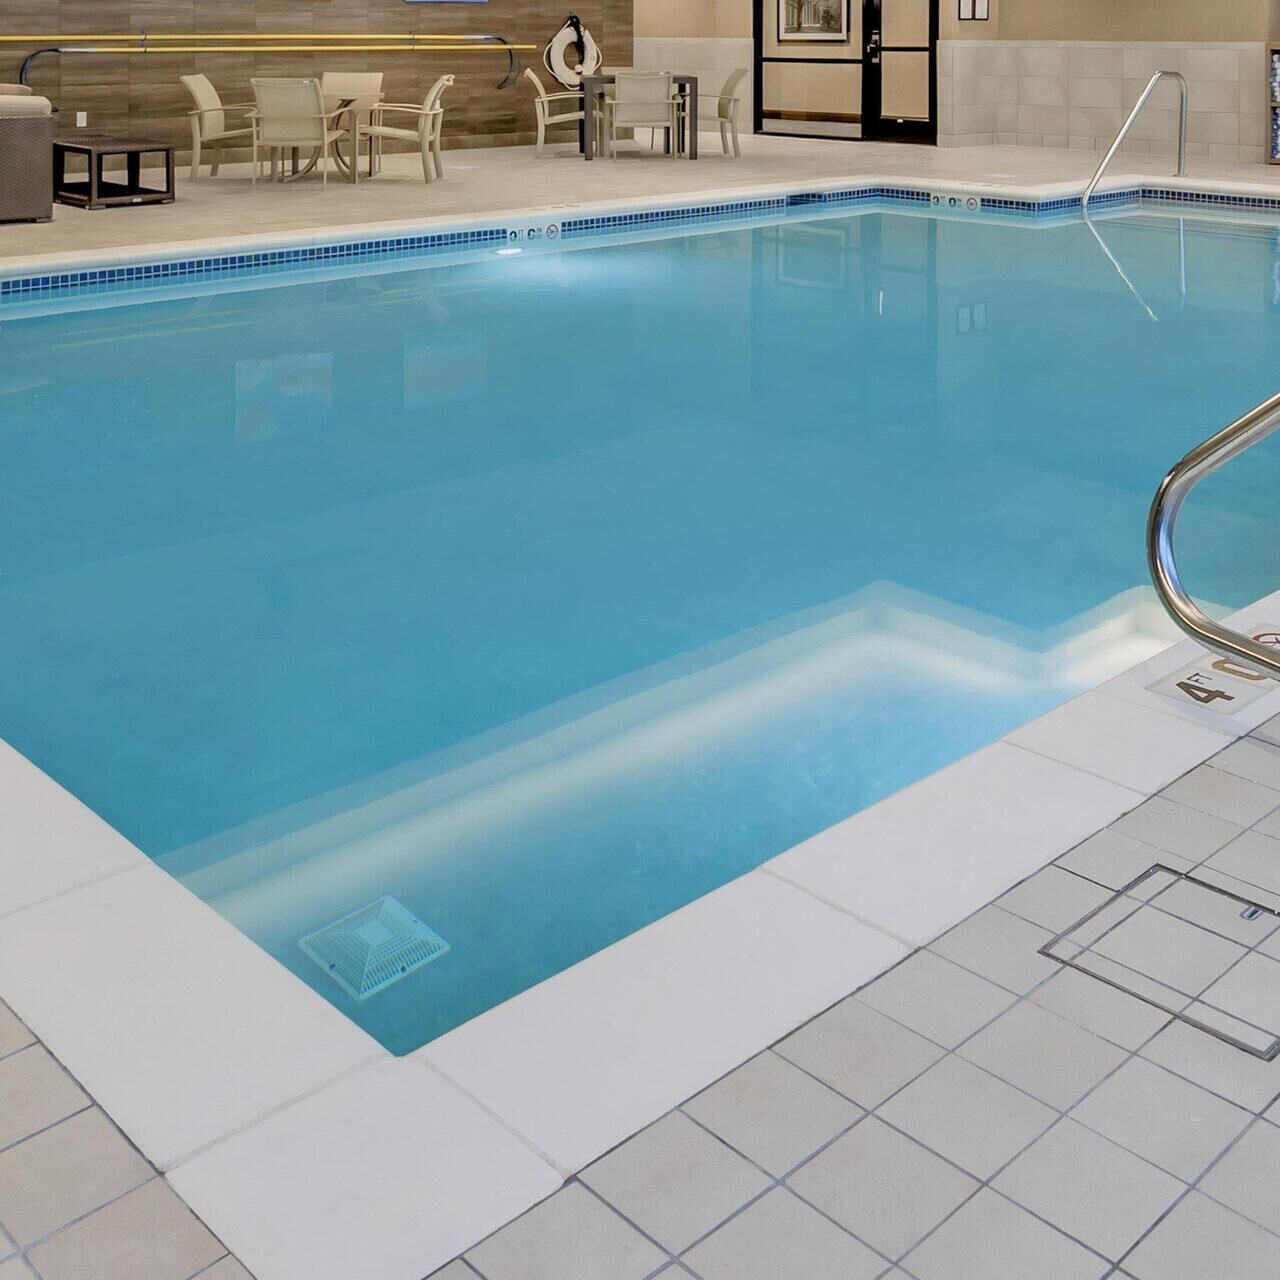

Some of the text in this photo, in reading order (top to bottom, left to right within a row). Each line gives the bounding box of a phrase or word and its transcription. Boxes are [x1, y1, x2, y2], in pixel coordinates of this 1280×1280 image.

[1175, 658, 1268, 704] 4 FT 0
